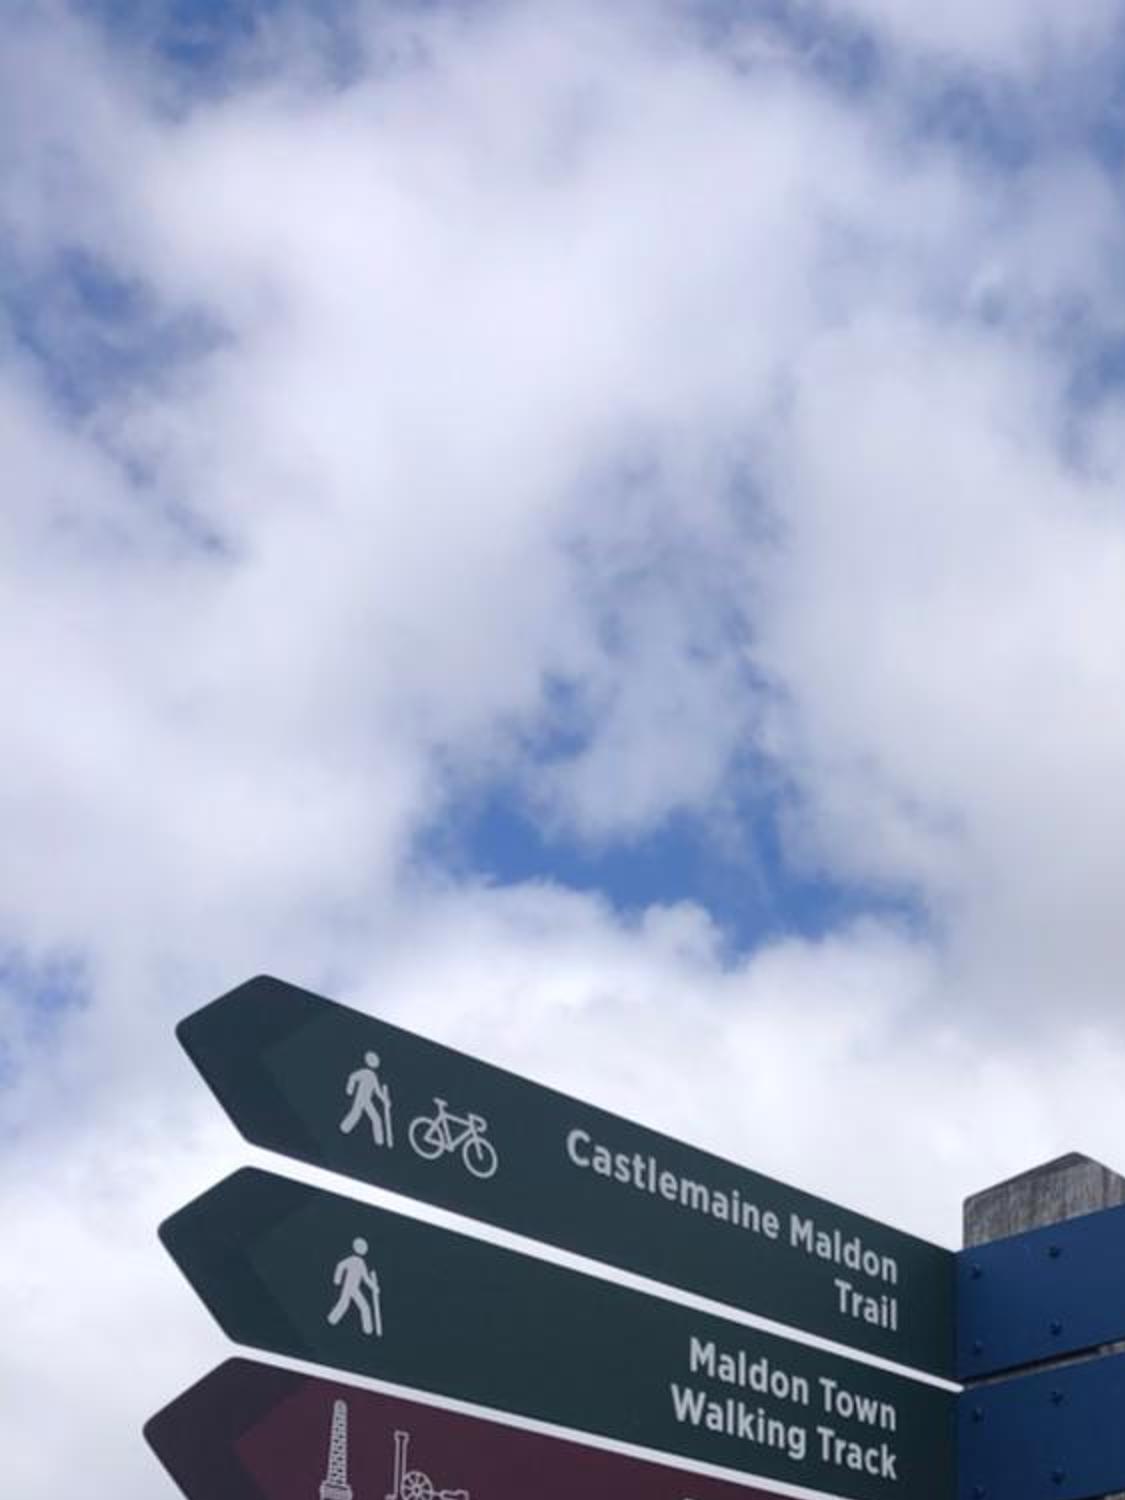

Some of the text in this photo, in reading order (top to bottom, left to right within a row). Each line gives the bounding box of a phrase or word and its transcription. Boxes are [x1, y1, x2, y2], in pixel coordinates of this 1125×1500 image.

[566, 1129, 897, 1284] Castlemaine Maldon
[834, 1278, 897, 1331] Trail
[670, 1383, 897, 1480] Walking Track
[689, 1336, 896, 1431] Maldon Town
